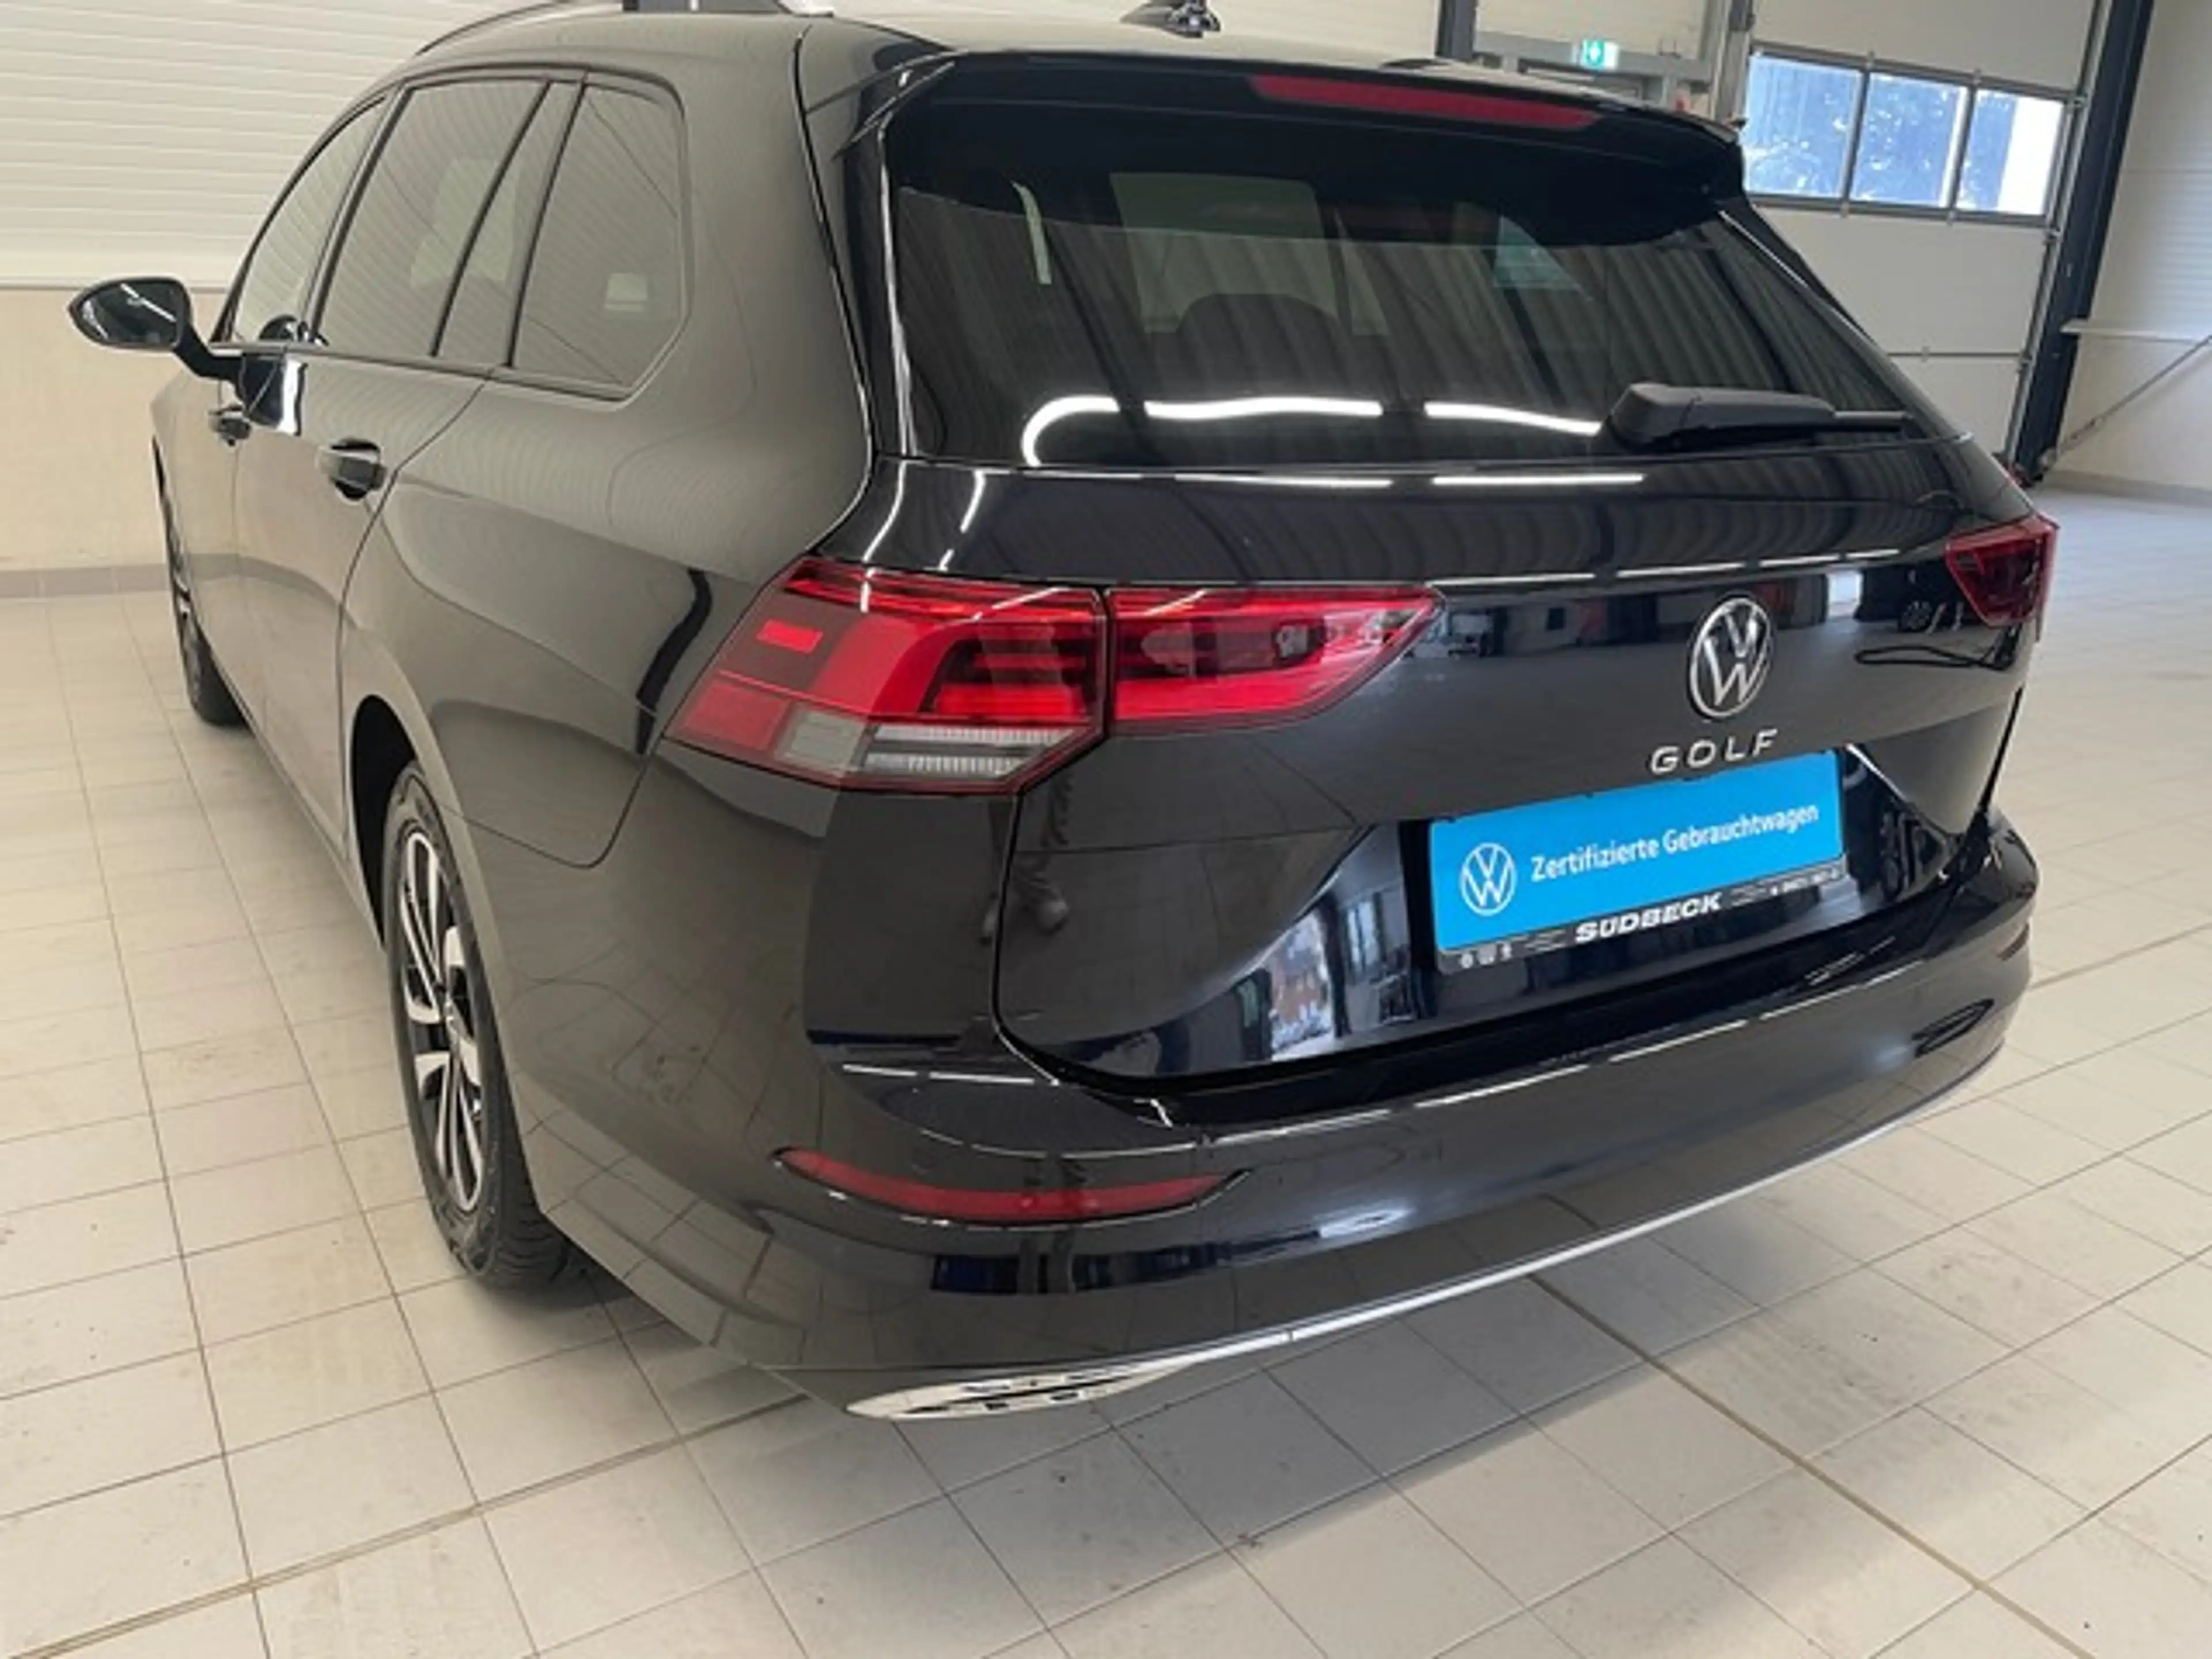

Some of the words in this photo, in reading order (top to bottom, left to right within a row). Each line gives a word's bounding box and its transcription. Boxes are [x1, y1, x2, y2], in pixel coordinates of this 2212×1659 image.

[1650, 728, 1778, 775] GOLF
[1530, 838, 1660, 882] Zertifizierte
[1662, 805, 1819, 854] Gebrauchtwagen
